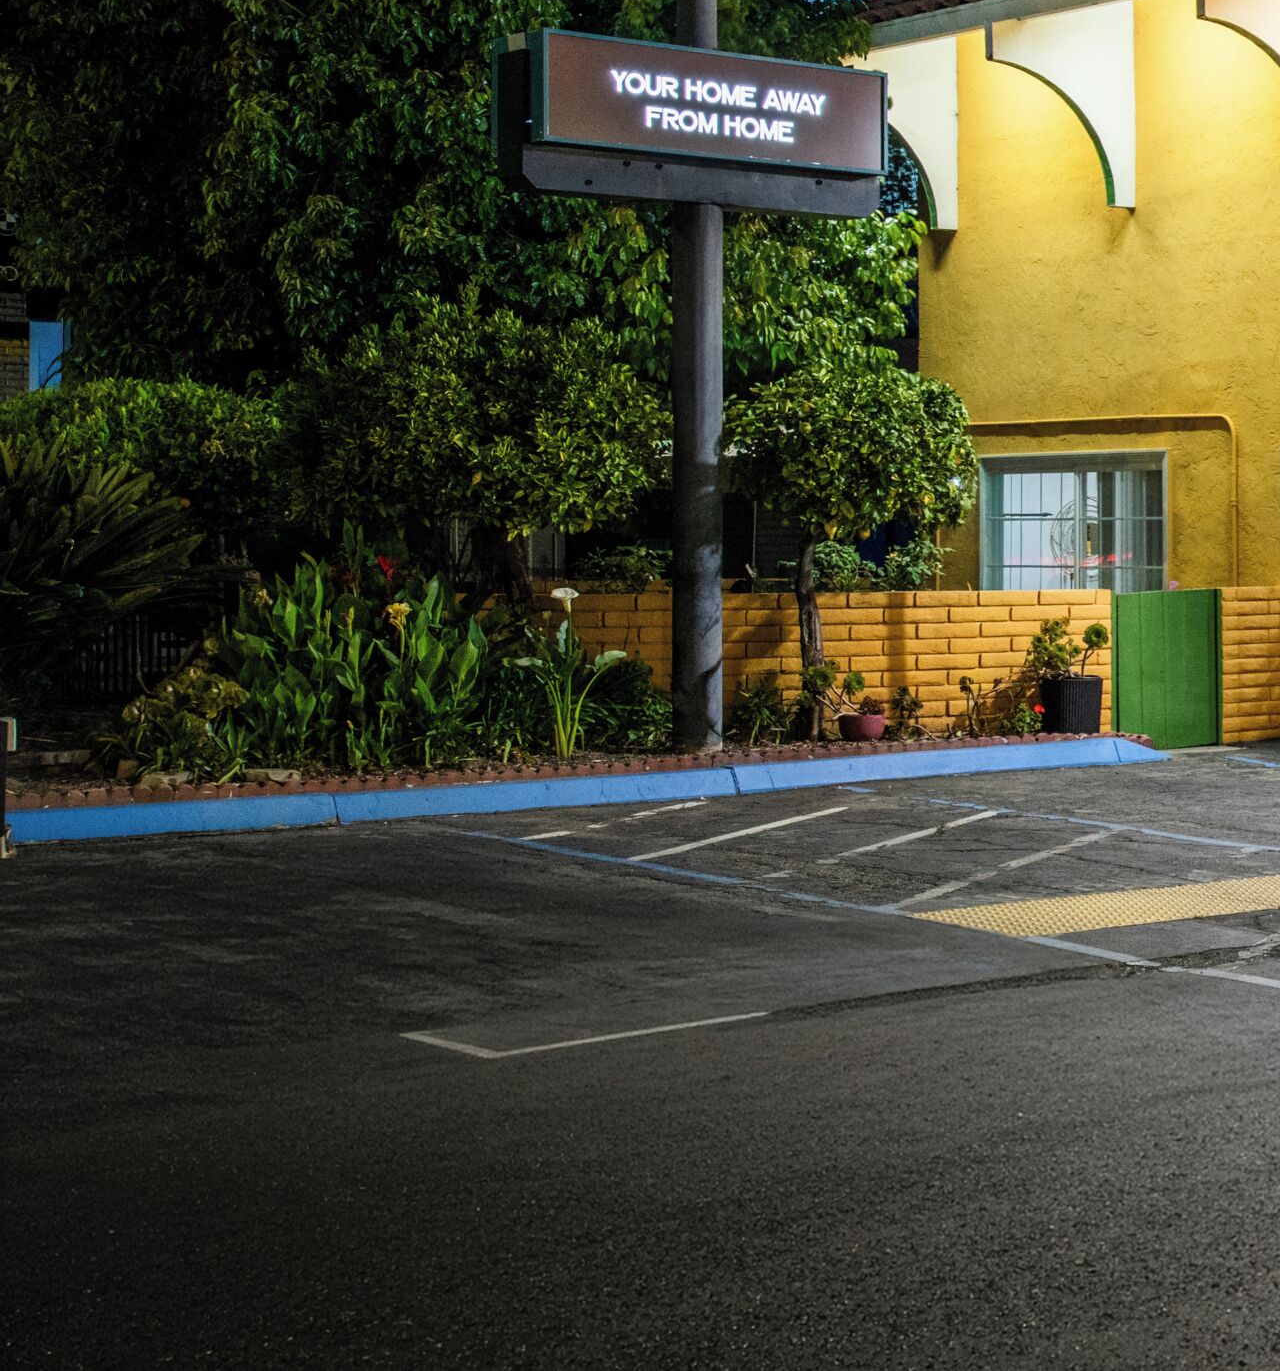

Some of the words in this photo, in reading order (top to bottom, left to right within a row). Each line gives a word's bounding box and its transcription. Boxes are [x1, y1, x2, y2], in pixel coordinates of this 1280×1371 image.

[610, 69, 679, 99] YOUR
[684, 78, 757, 108] HOME
[762, 88, 827, 116] AWAY
[645, 105, 718, 135] FROM
[723, 114, 795, 144] HOME
